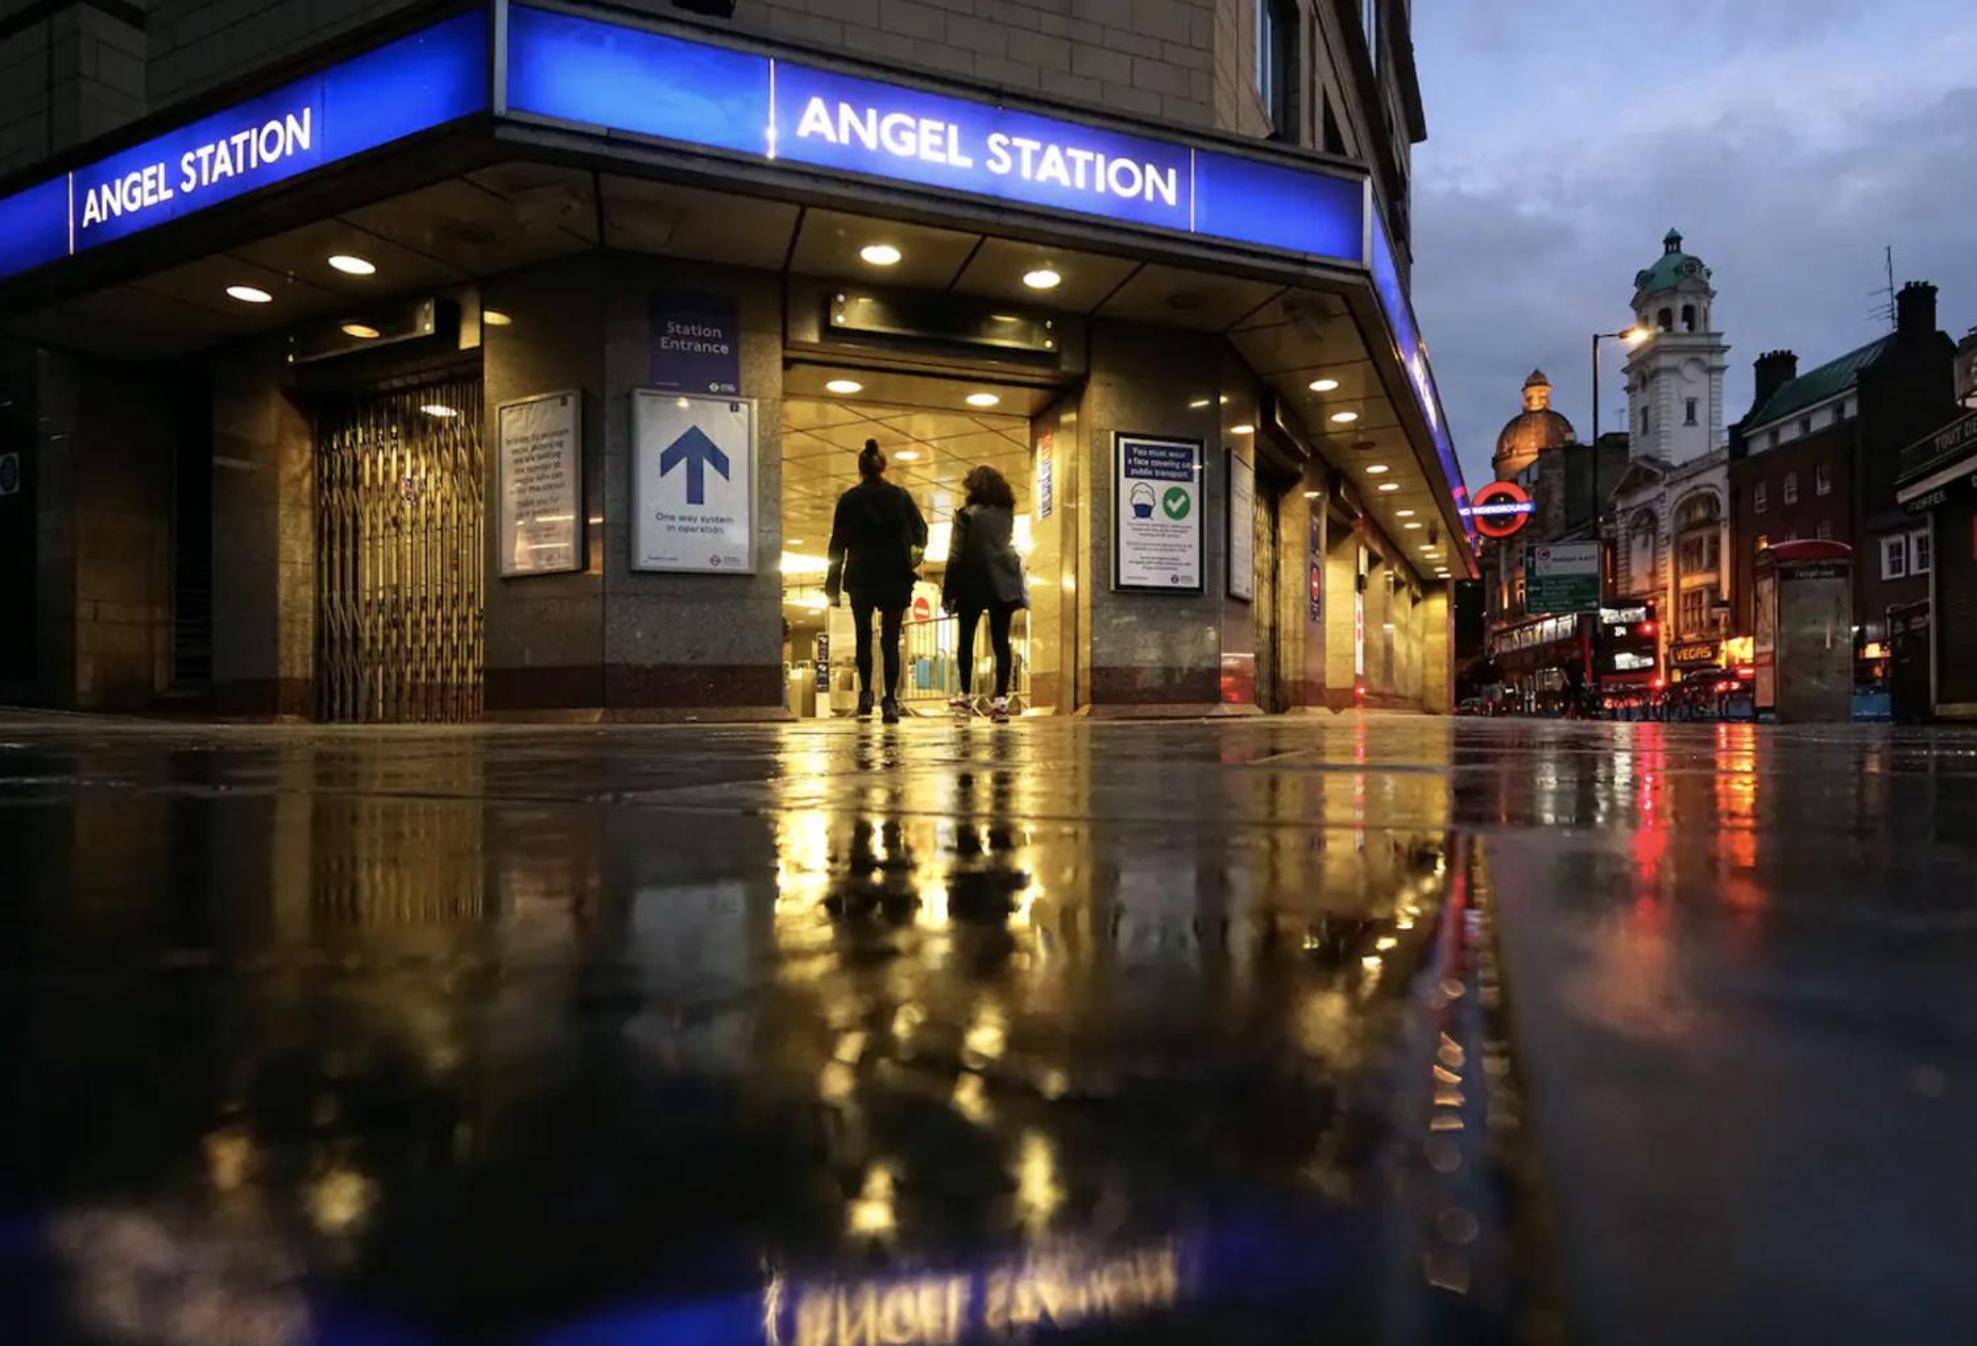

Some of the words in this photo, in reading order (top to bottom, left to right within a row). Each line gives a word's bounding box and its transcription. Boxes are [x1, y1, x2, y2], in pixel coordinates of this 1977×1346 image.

[794, 95, 973, 168] ANGEL
[985, 132, 1178, 207] STATION
[82, 162, 174, 228] ANGEL
[180, 107, 312, 193] STATION
[666, 320, 722, 338] Station
[660, 336, 729, 355] Entrance
[1132, 447, 1147, 455] You
[1133, 457, 1149, 465] face
[1150, 460, 1181, 469] covering
[1130, 467, 1153, 476] public
[655, 511, 676, 521] One
[678, 515, 698, 523] way
[700, 515, 735, 524] system
[666, 524, 676, 532] in
[678, 525, 725, 534] operation
[1676, 646, 1712, 661] VEGAS
